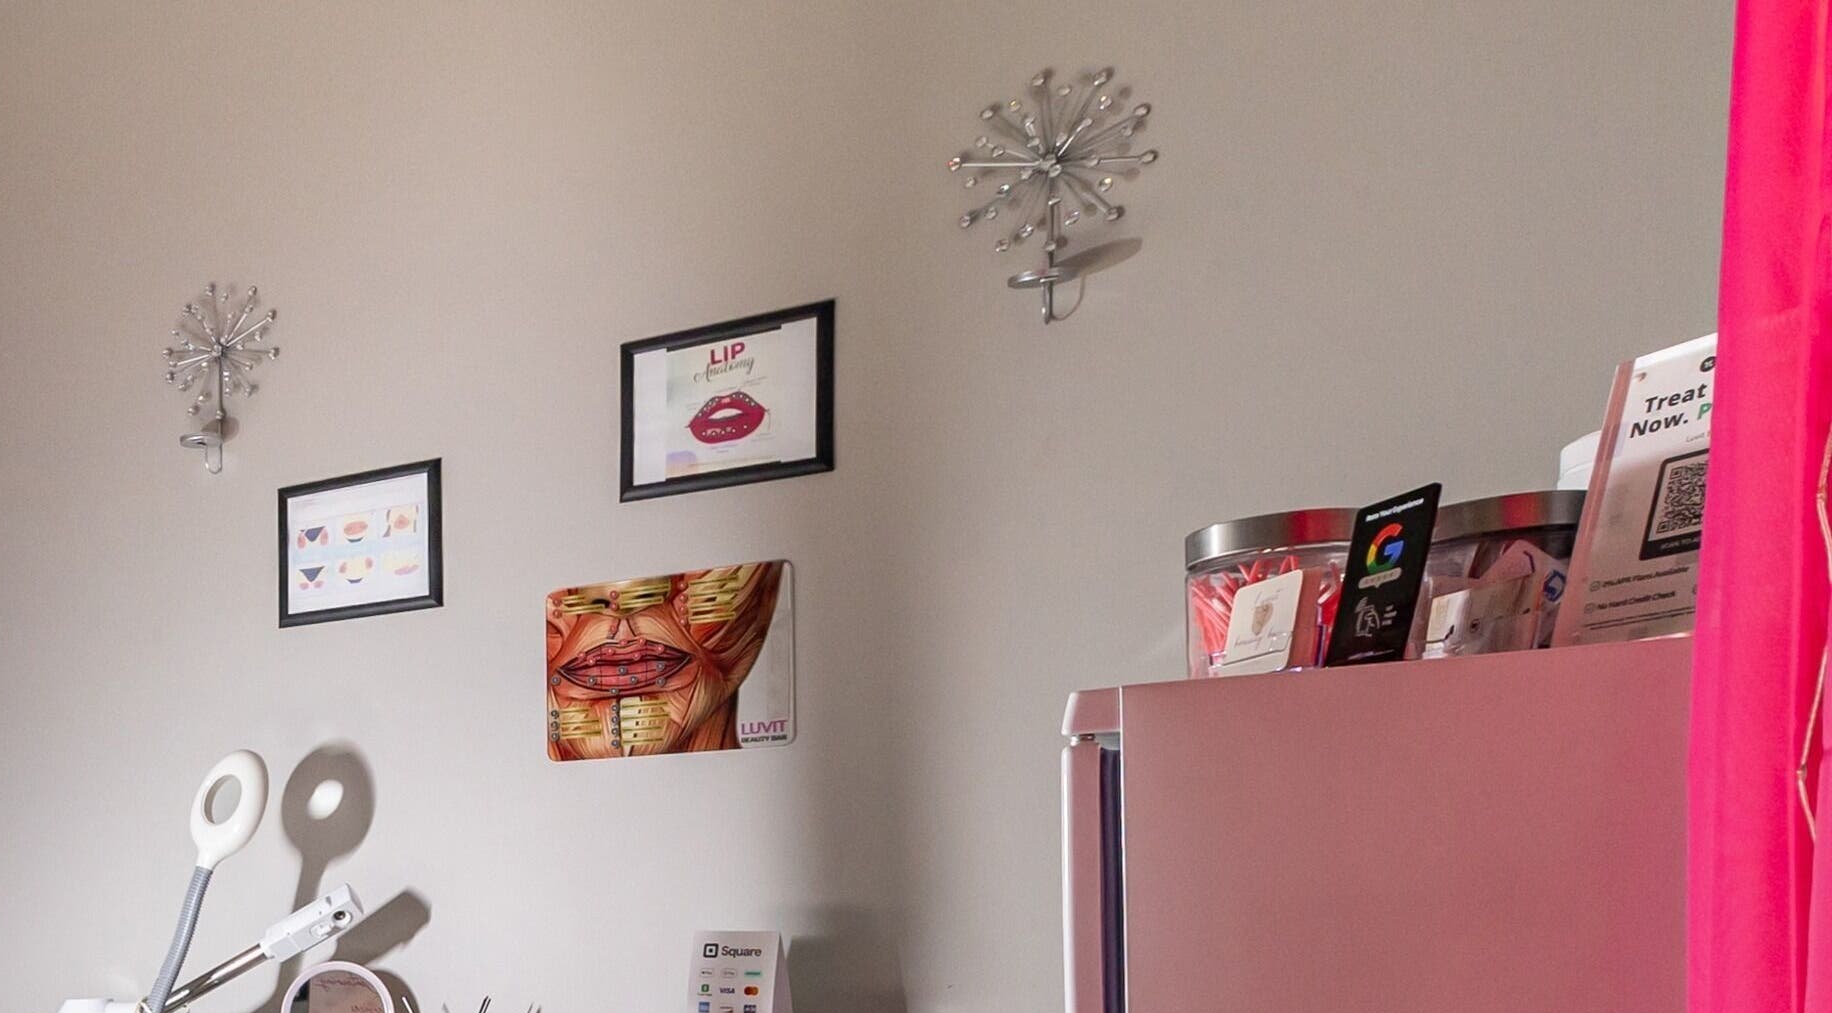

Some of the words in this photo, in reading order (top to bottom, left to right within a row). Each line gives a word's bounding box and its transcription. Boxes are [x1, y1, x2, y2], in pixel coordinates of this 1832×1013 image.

[710, 342, 746, 366] LIP
[694, 356, 755, 383] Anatomy
[1645, 383, 1707, 413] Treat
[1629, 412, 1689, 439] Now.
[741, 719, 788, 736] LUVIT
[721, 945, 762, 958] Square
